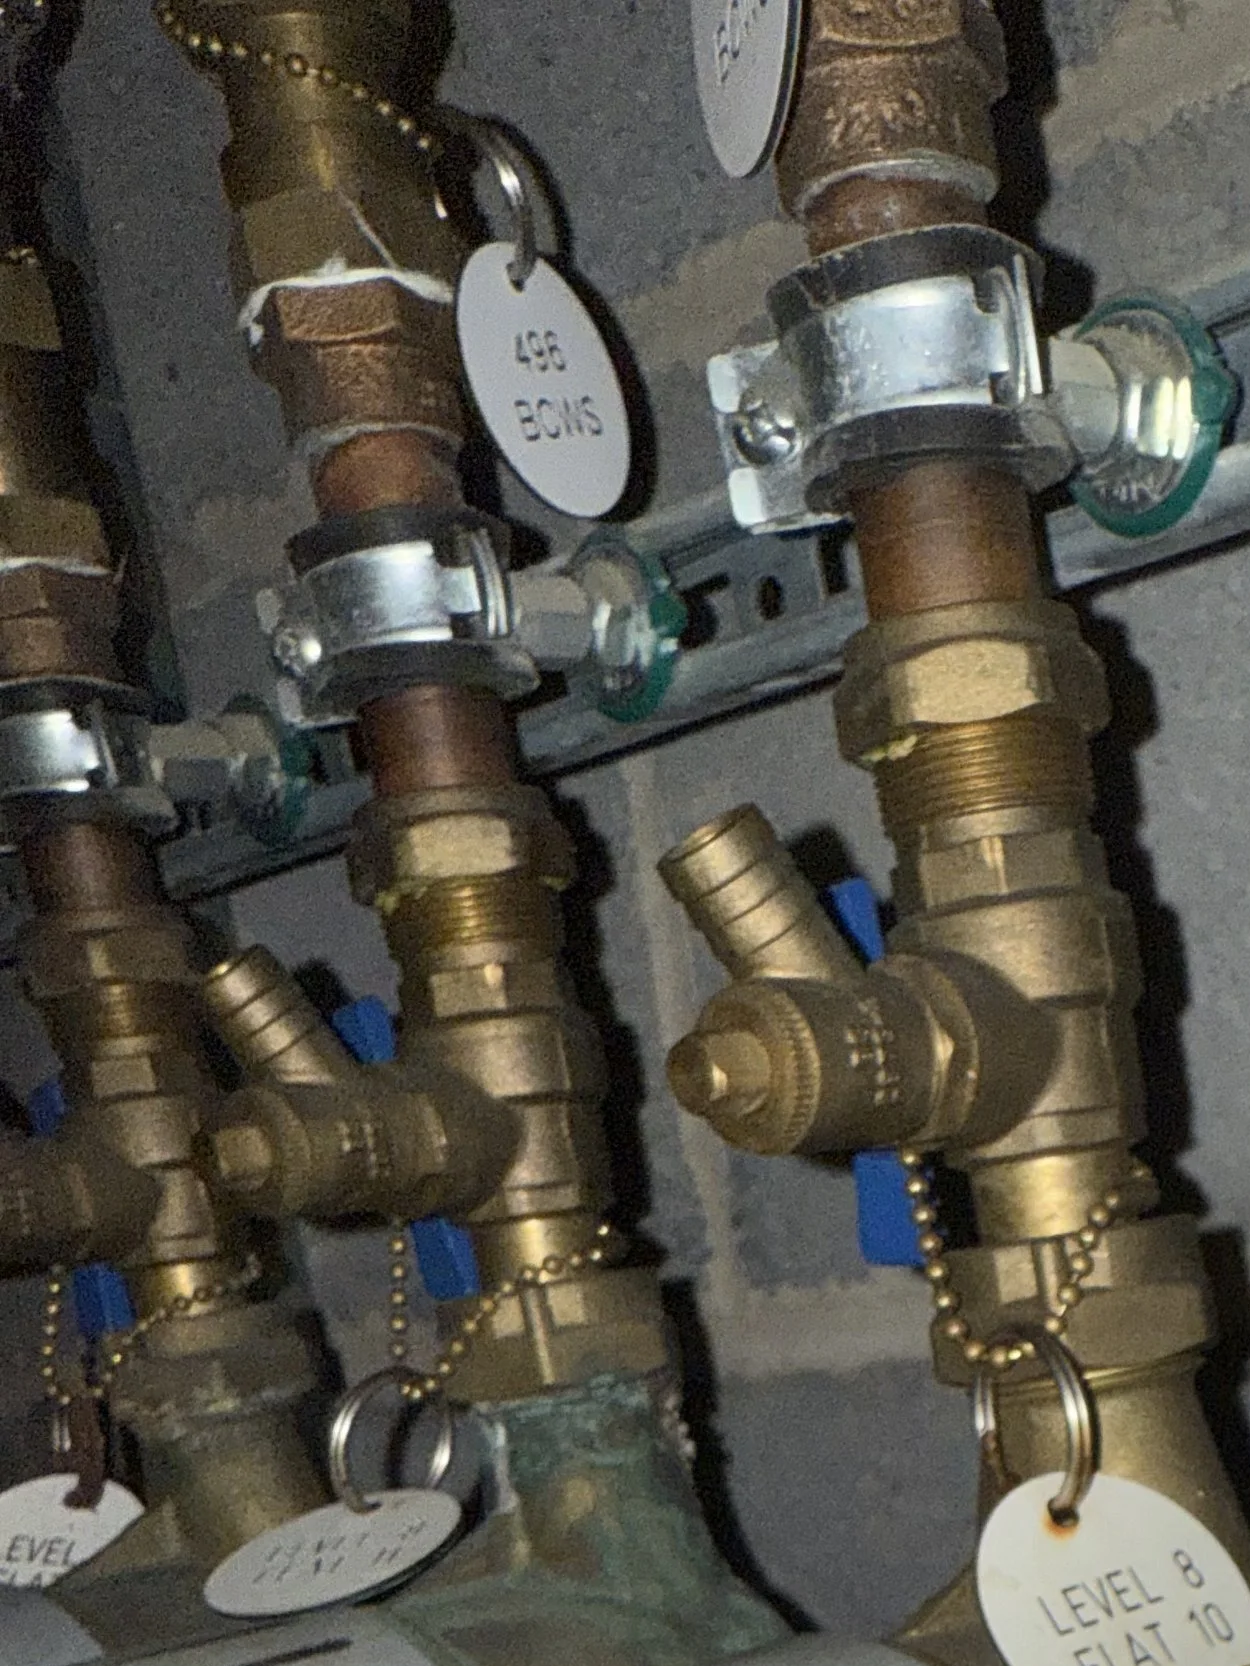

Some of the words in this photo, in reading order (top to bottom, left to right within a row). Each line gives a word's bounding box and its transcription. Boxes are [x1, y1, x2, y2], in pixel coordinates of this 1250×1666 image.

[1037, 1565, 1165, 1637] LEVEL
[1172, 1549, 1206, 1589] 8
[1188, 1602, 1235, 1648] 10
